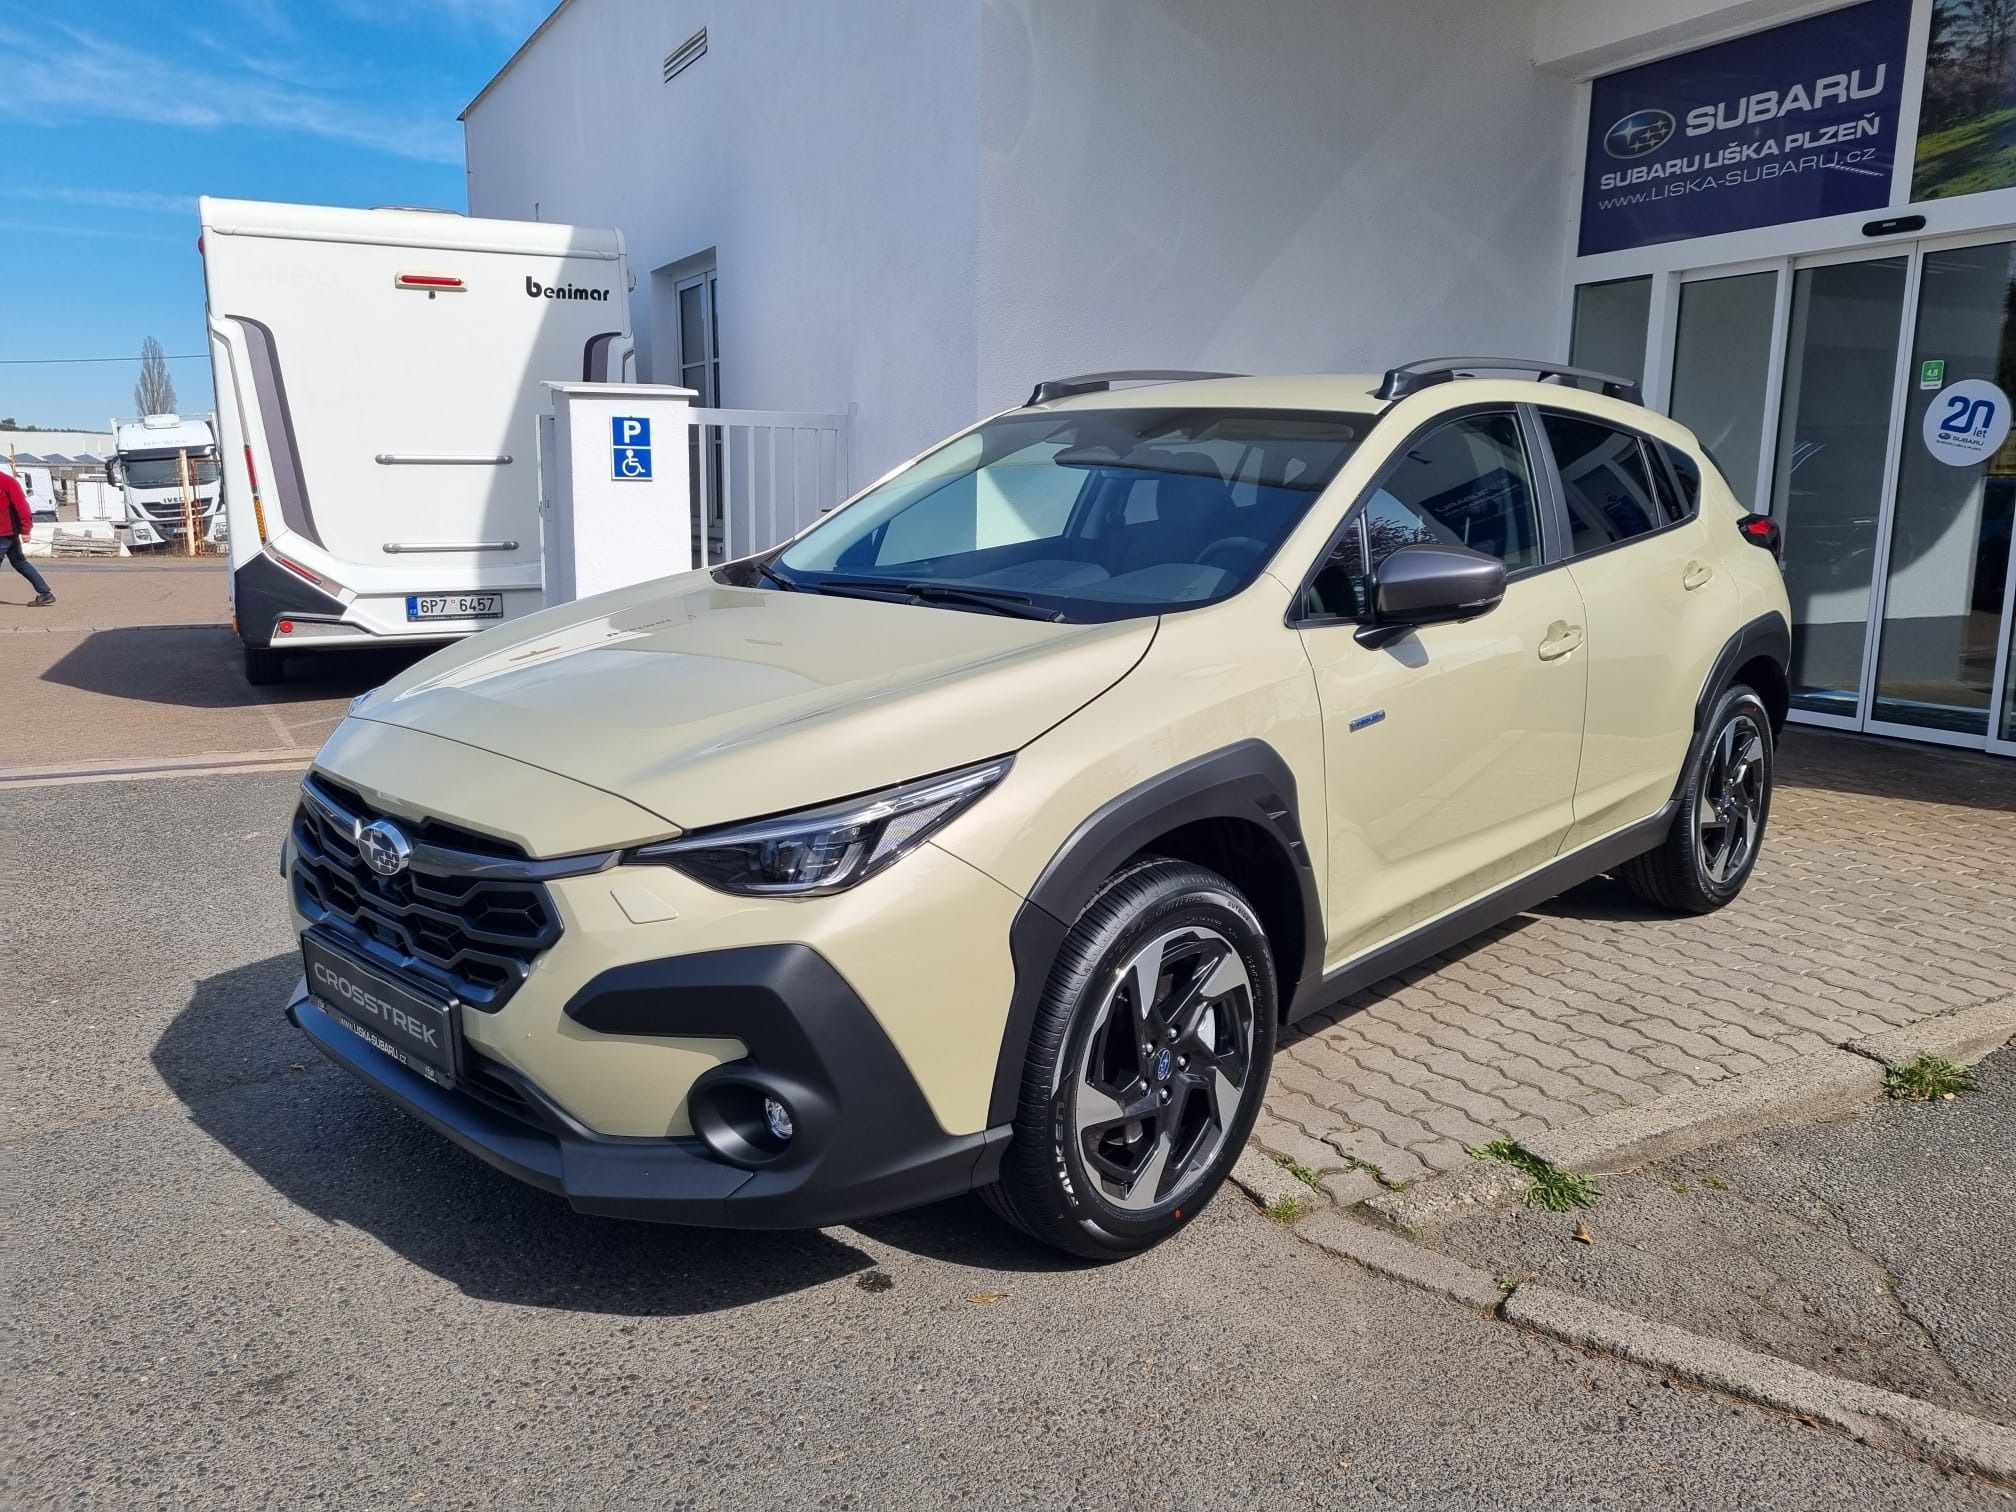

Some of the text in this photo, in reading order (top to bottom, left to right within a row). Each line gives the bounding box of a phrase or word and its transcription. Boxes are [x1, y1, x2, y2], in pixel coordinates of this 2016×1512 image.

[1685, 63, 1887, 137] SUBARU
[1600, 113, 1880, 190] SUBARU LIŠKA PLZEŇ
[525, 276, 610, 301] benimar
[623, 420, 641, 443] P
[1973, 427, 1988, 439] let
[420, 597, 494, 613] 6P7 6457
[314, 962, 439, 1049] CROSSTREK
